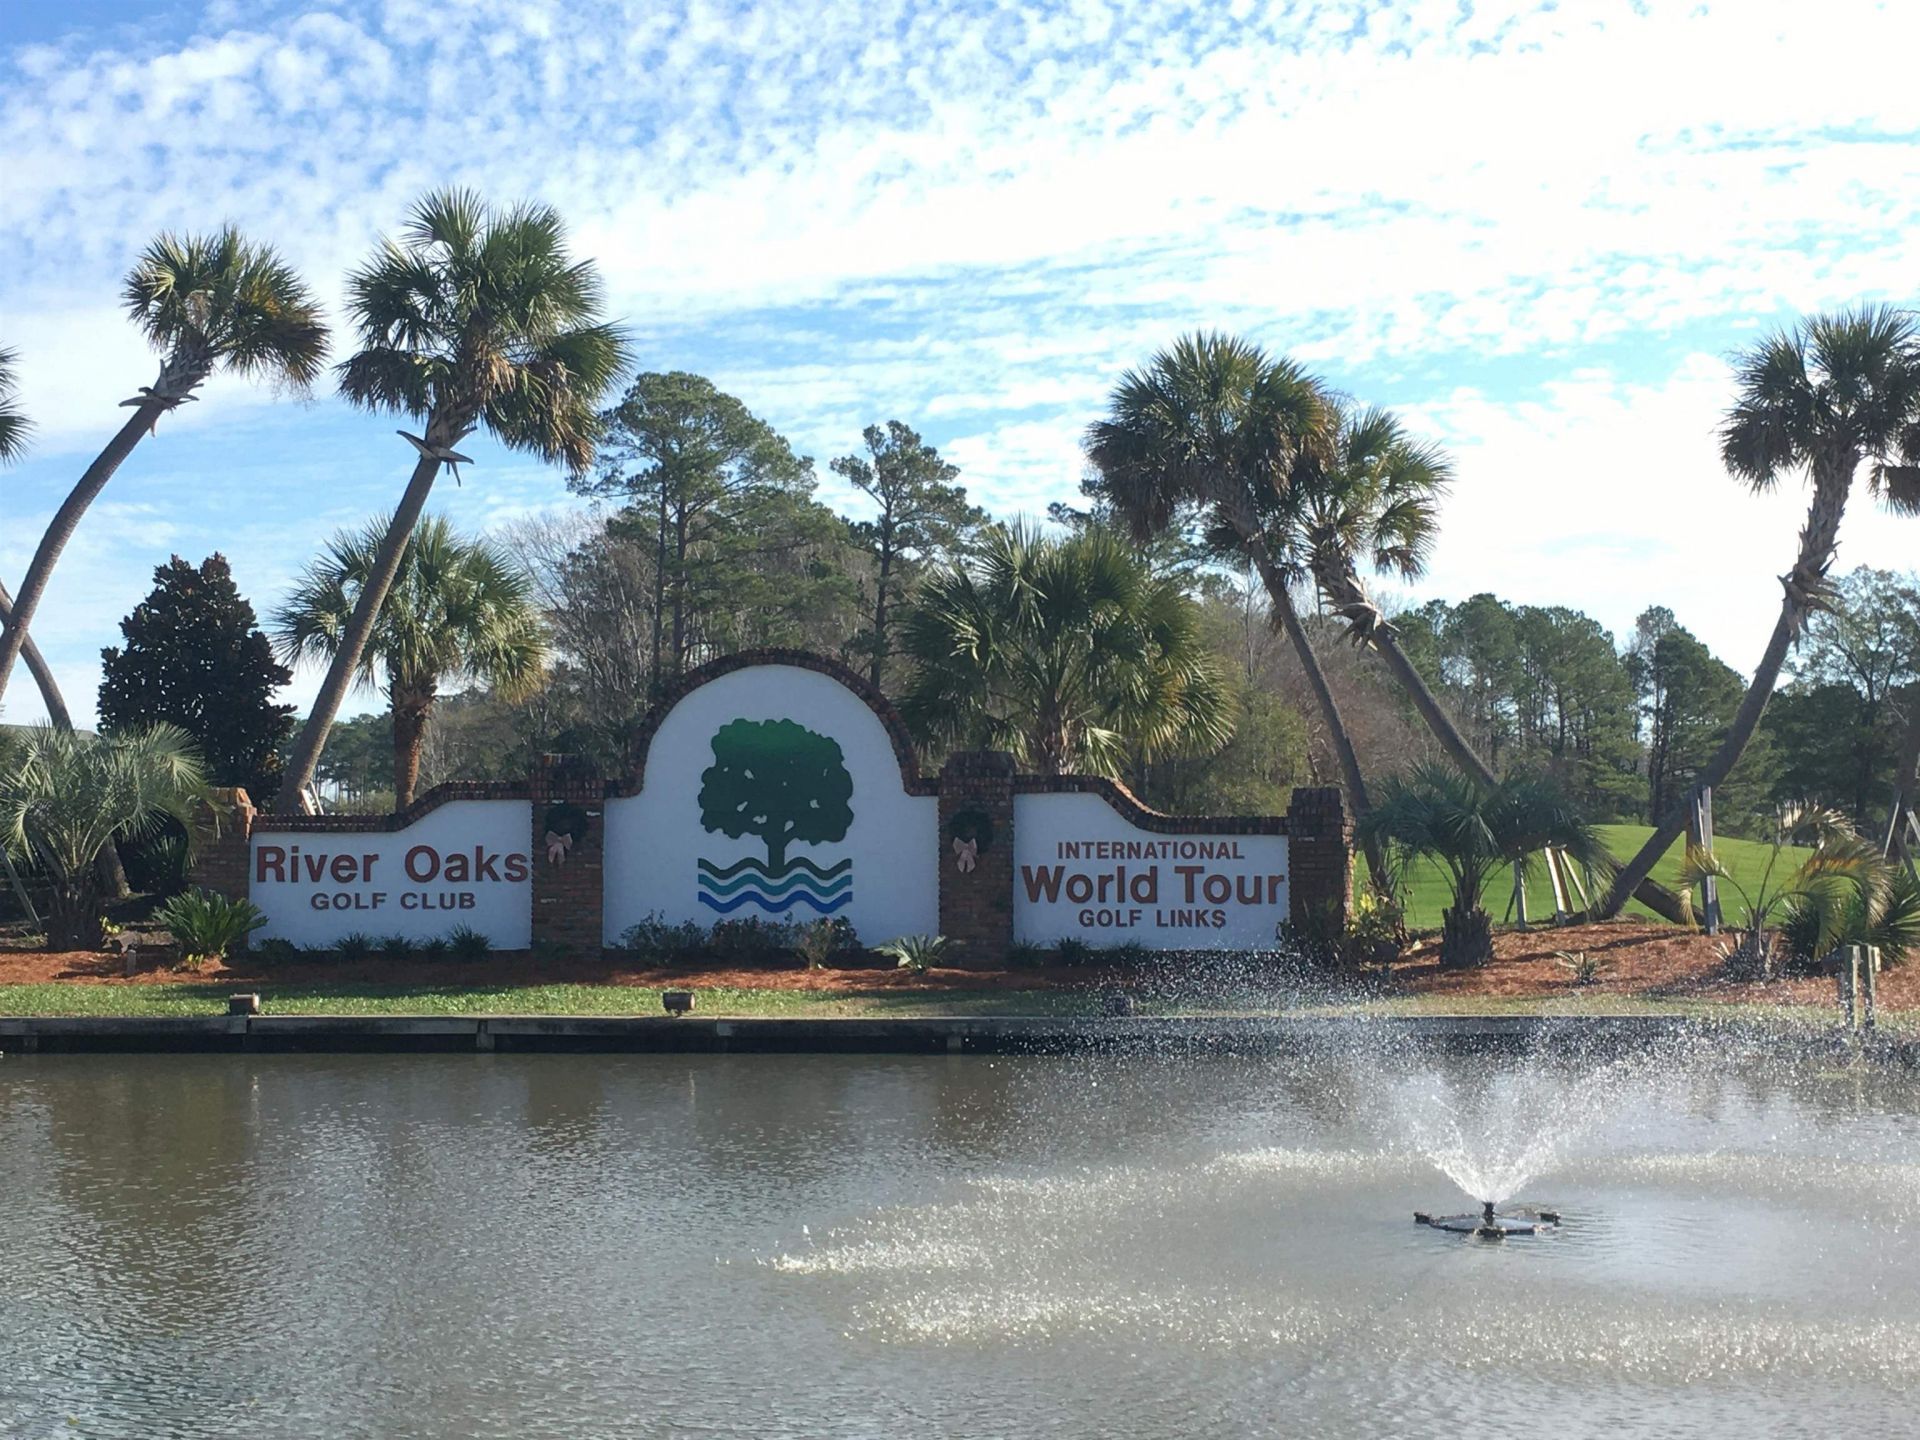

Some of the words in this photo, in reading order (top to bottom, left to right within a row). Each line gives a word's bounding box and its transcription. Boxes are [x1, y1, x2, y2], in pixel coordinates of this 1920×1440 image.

[1057, 841, 1245, 860] INTERNATIONAL
[256, 845, 380, 883] River
[404, 844, 529, 883] Oaks
[1021, 865, 1158, 905] World
[1174, 865, 1285, 905] Tour
[310, 892, 387, 910] GOLF
[400, 892, 476, 910] CLUB
[1078, 909, 1142, 928] GOLF
[1156, 909, 1227, 928] LINKS
